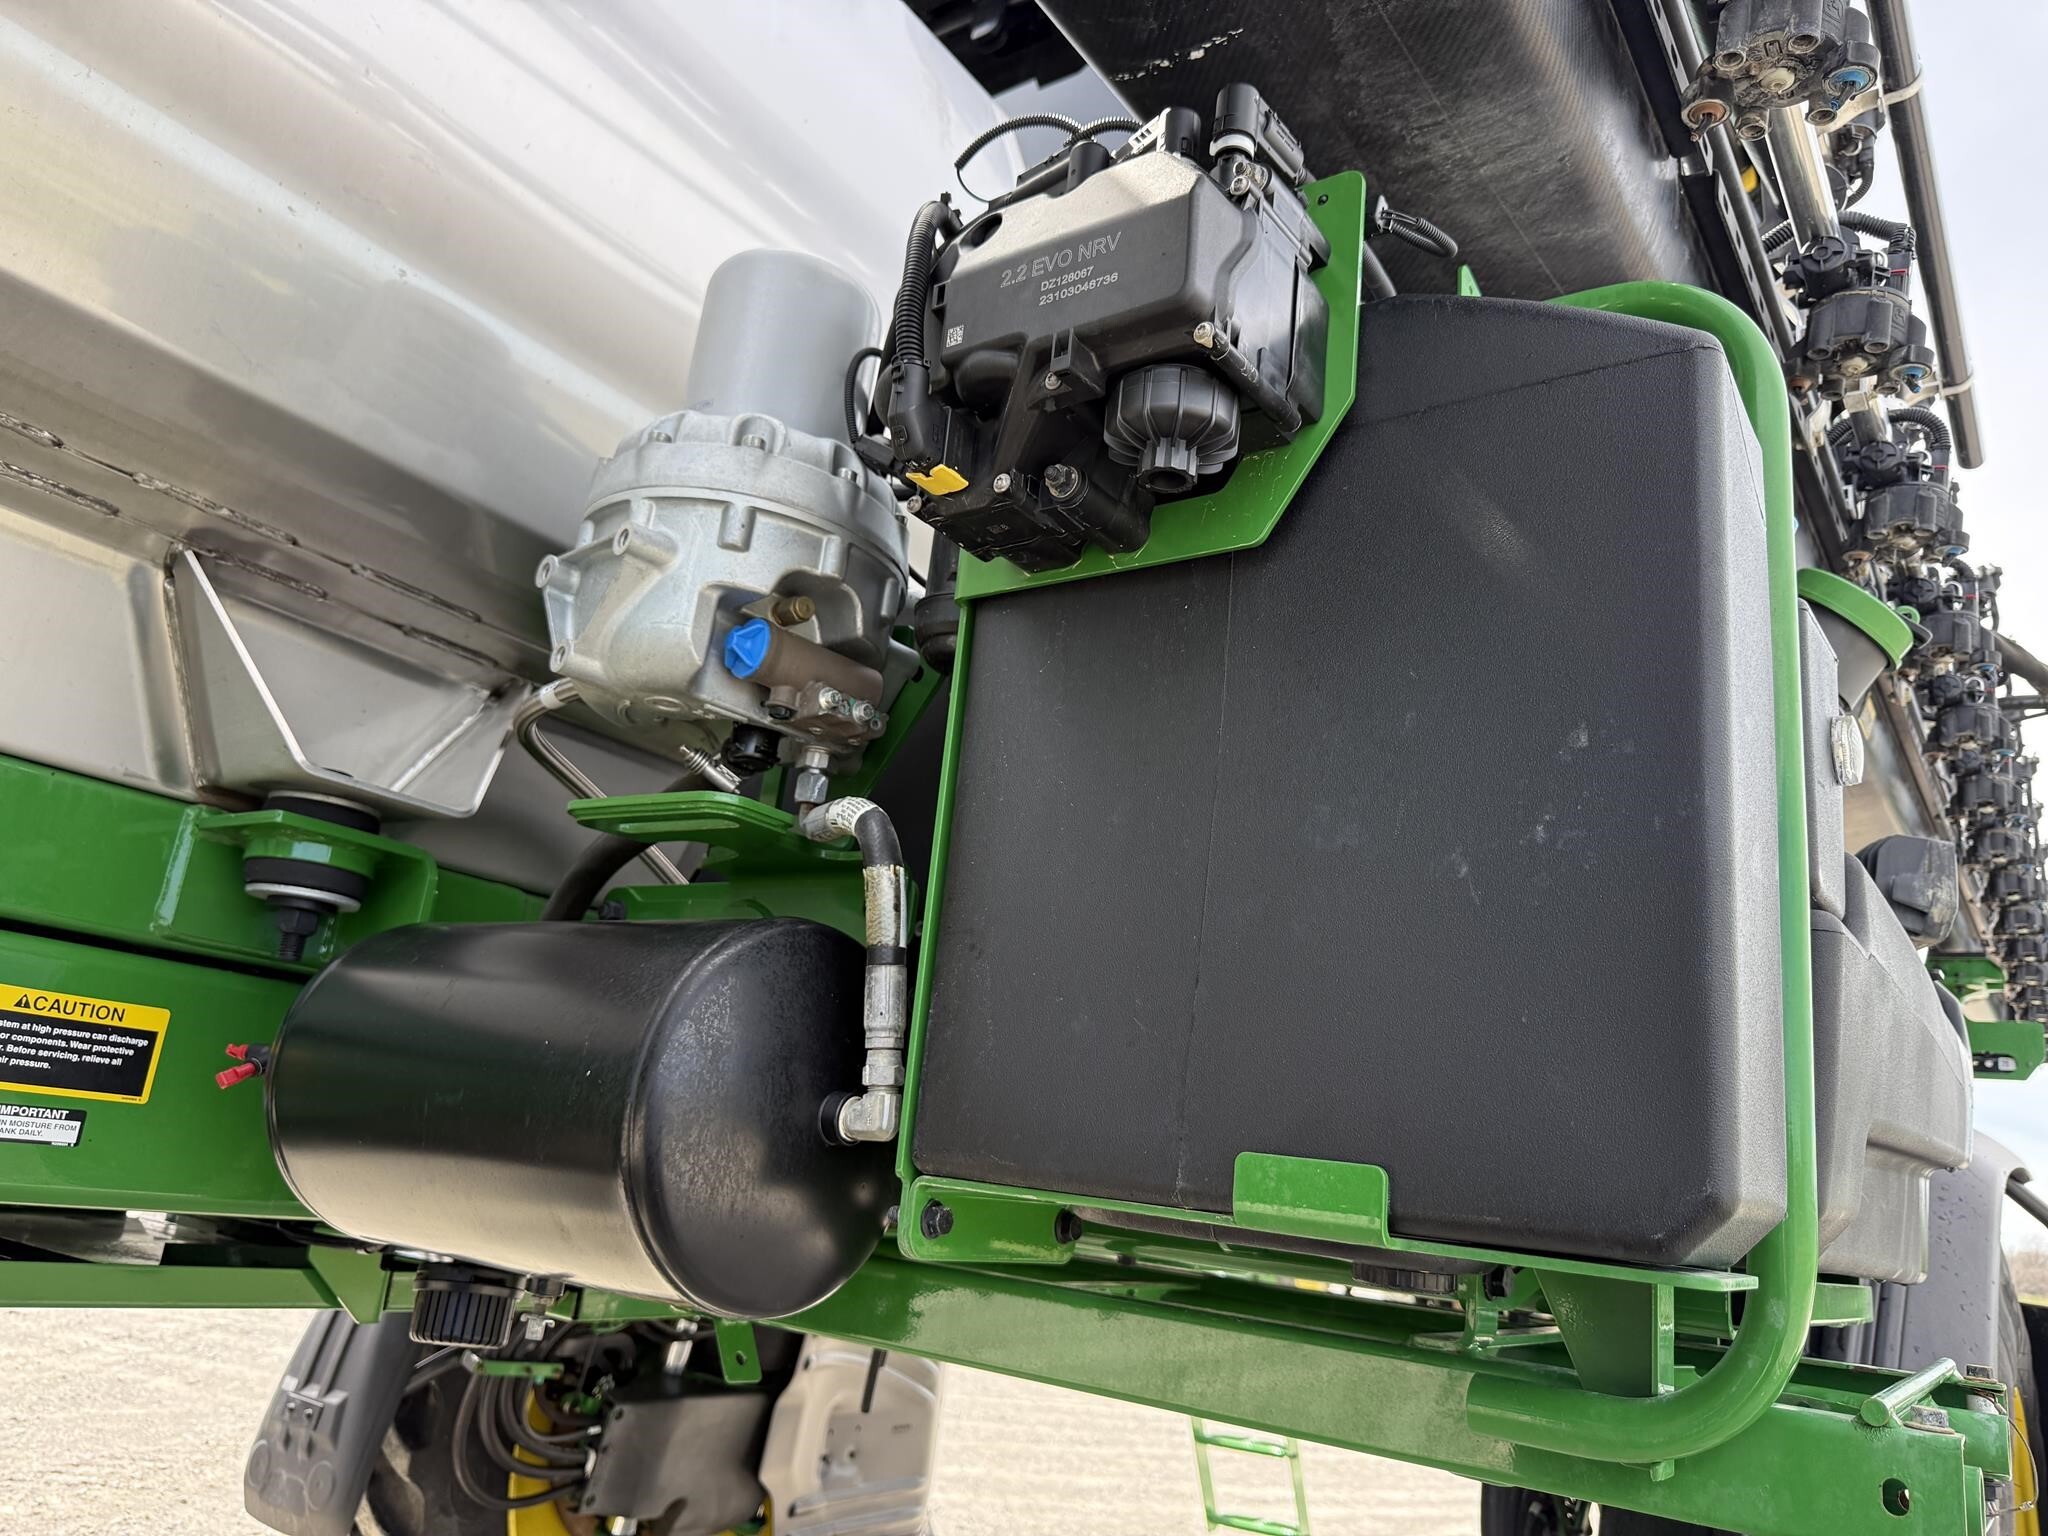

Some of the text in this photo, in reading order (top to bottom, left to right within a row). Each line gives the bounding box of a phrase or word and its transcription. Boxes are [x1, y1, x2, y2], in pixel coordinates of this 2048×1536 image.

[1000, 231, 1122, 289] 2.2 EVO NRV
[33, 996, 126, 1023] CAUTION
[11, 1034, 68, 1048] components.
[70, 1040, 92, 1051] Wear
[92, 1044, 134, 1056] protective
[21, 1022, 31, 1031] at
[32, 1023, 52, 1034] high
[53, 1027, 91, 1039] pressure
[92, 1032, 108, 1041] can
[108, 1034, 149, 1047] discharge
[6, 1044, 37, 1055] Before
[81, 1054, 110, 1065] relieve
[111, 1057, 123, 1066] all
[9, 1057, 51, 1069] pressure.
[8, 1120, 52, 1130] MOISTURE
[53, 1123, 77, 1132] FROM
[18, 1129, 43, 1137] DAILY.
